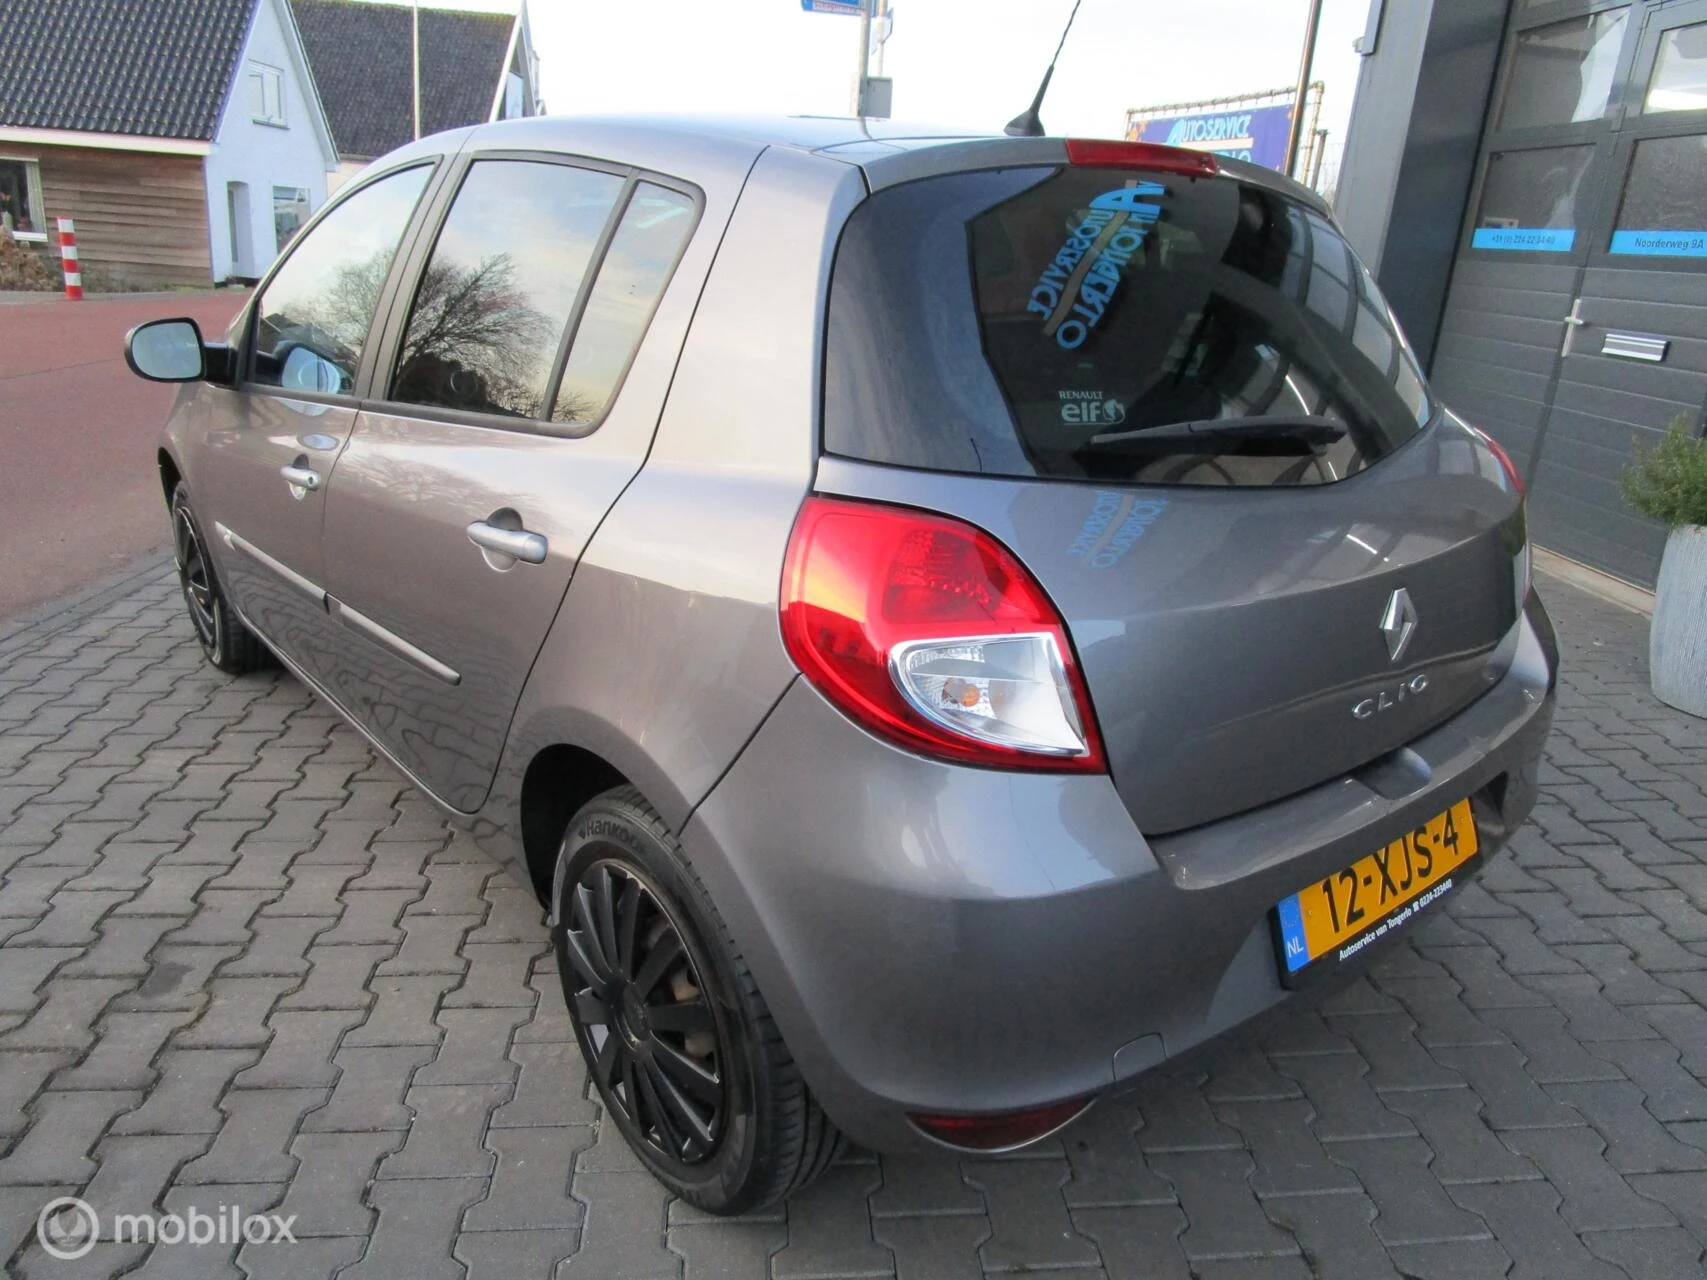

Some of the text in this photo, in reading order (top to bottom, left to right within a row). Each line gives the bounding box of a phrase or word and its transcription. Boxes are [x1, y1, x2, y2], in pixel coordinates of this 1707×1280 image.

[1634, 237, 1704, 251] Noorderweg 9A
[1058, 390, 1104, 400] RENAULT
[1061, 402, 1101, 423] elf
[1352, 674, 1428, 718] CLIO
[1323, 809, 1458, 933] 12-XJS-4
[1338, 931, 1376, 961] Autoservice
[1375, 924, 1388, 938] van
[1387, 907, 1412, 928] Tongerlo
[1286, 936, 1305, 958] NL
